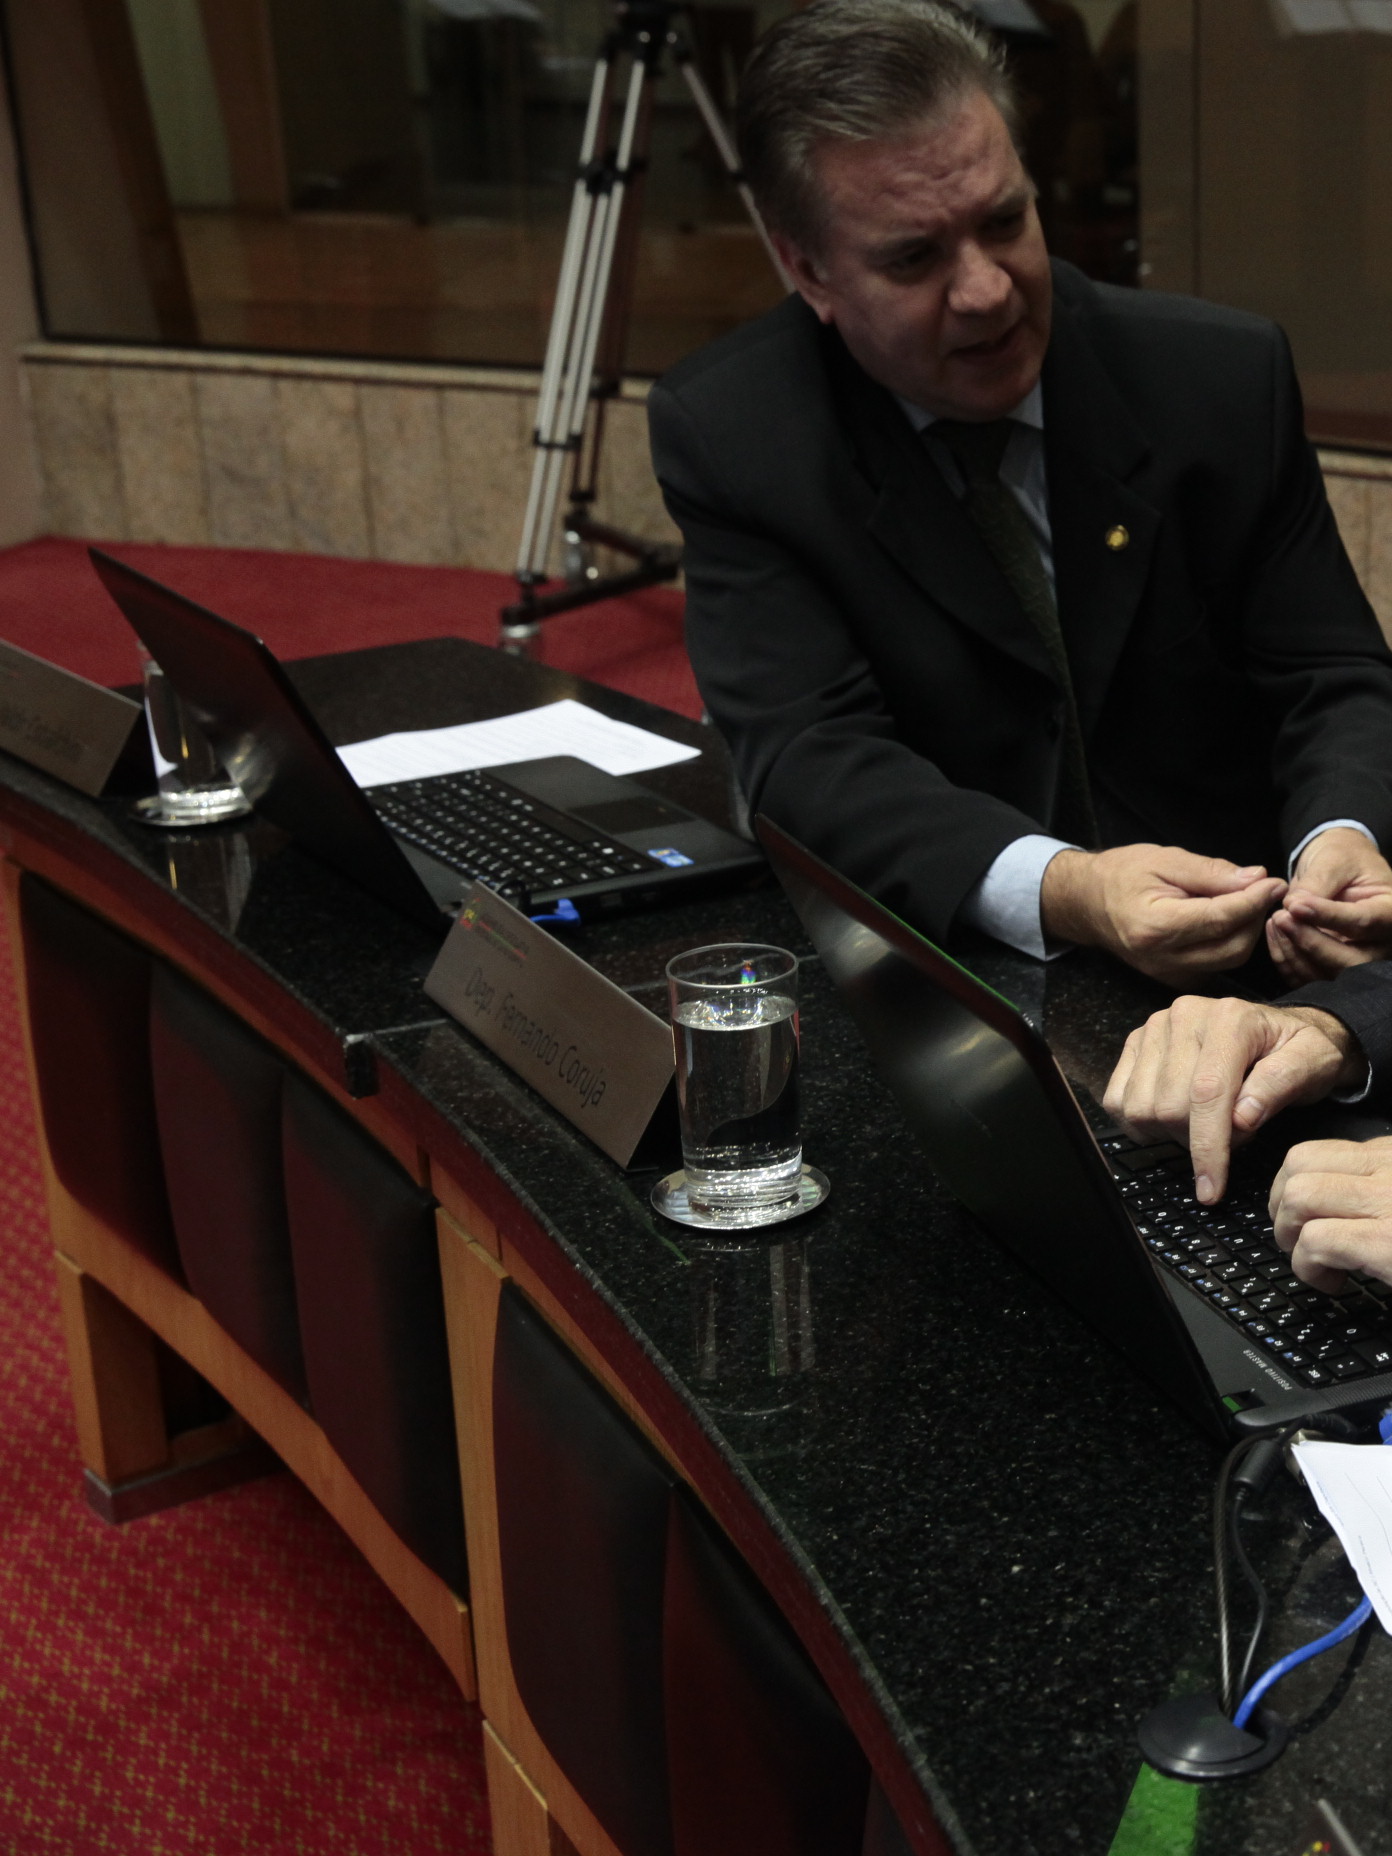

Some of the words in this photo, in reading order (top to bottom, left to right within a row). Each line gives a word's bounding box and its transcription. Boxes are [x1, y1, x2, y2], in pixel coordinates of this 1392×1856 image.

[465, 967, 496, 1016] Dep.
[495, 993, 560, 1066] Fernando
[558, 1046, 607, 1109] Coruja
[1242, 1349, 1268, 1369] MASTER
[1264, 1368, 1293, 1391] POSITIVO
